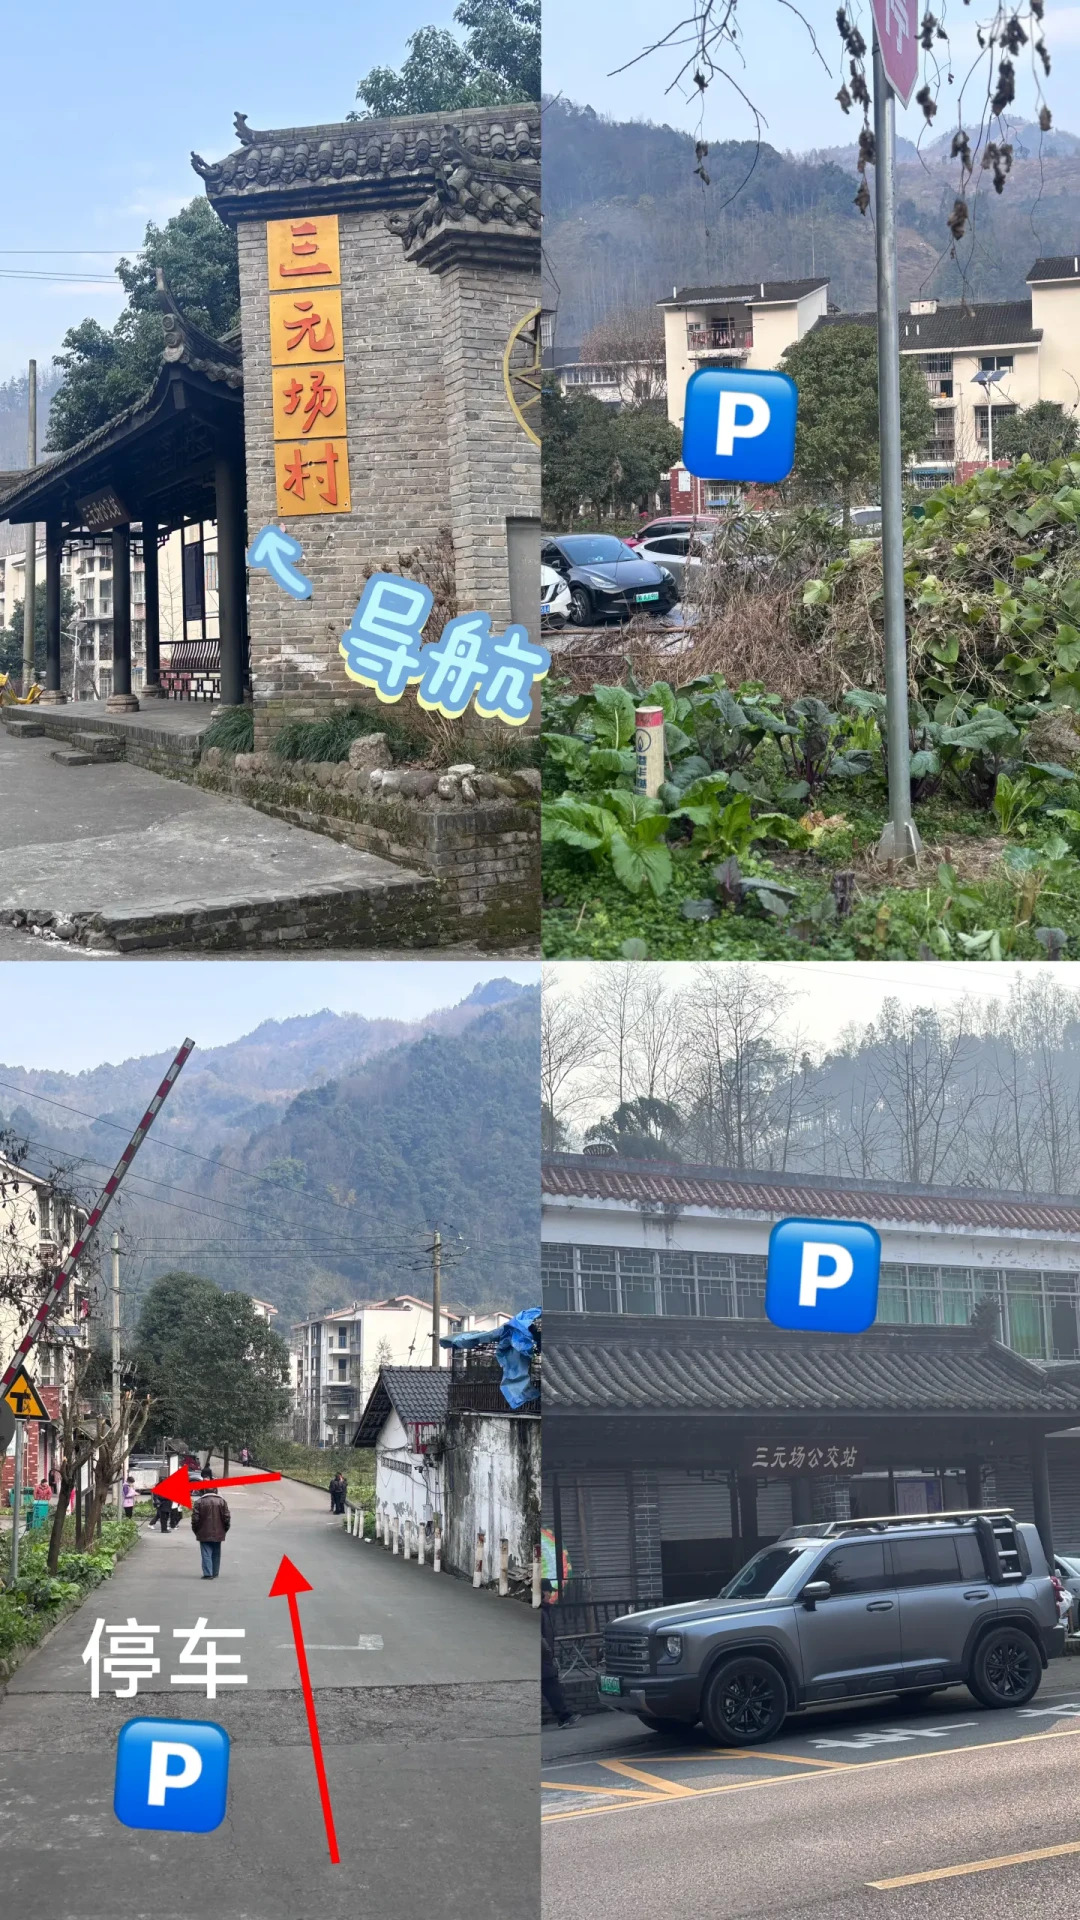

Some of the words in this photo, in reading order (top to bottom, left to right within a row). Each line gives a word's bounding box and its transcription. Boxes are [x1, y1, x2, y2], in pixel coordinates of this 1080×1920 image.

[279, 221, 340, 506] 三元场村
[752, 1445, 858, 1469] 三元场公交站
